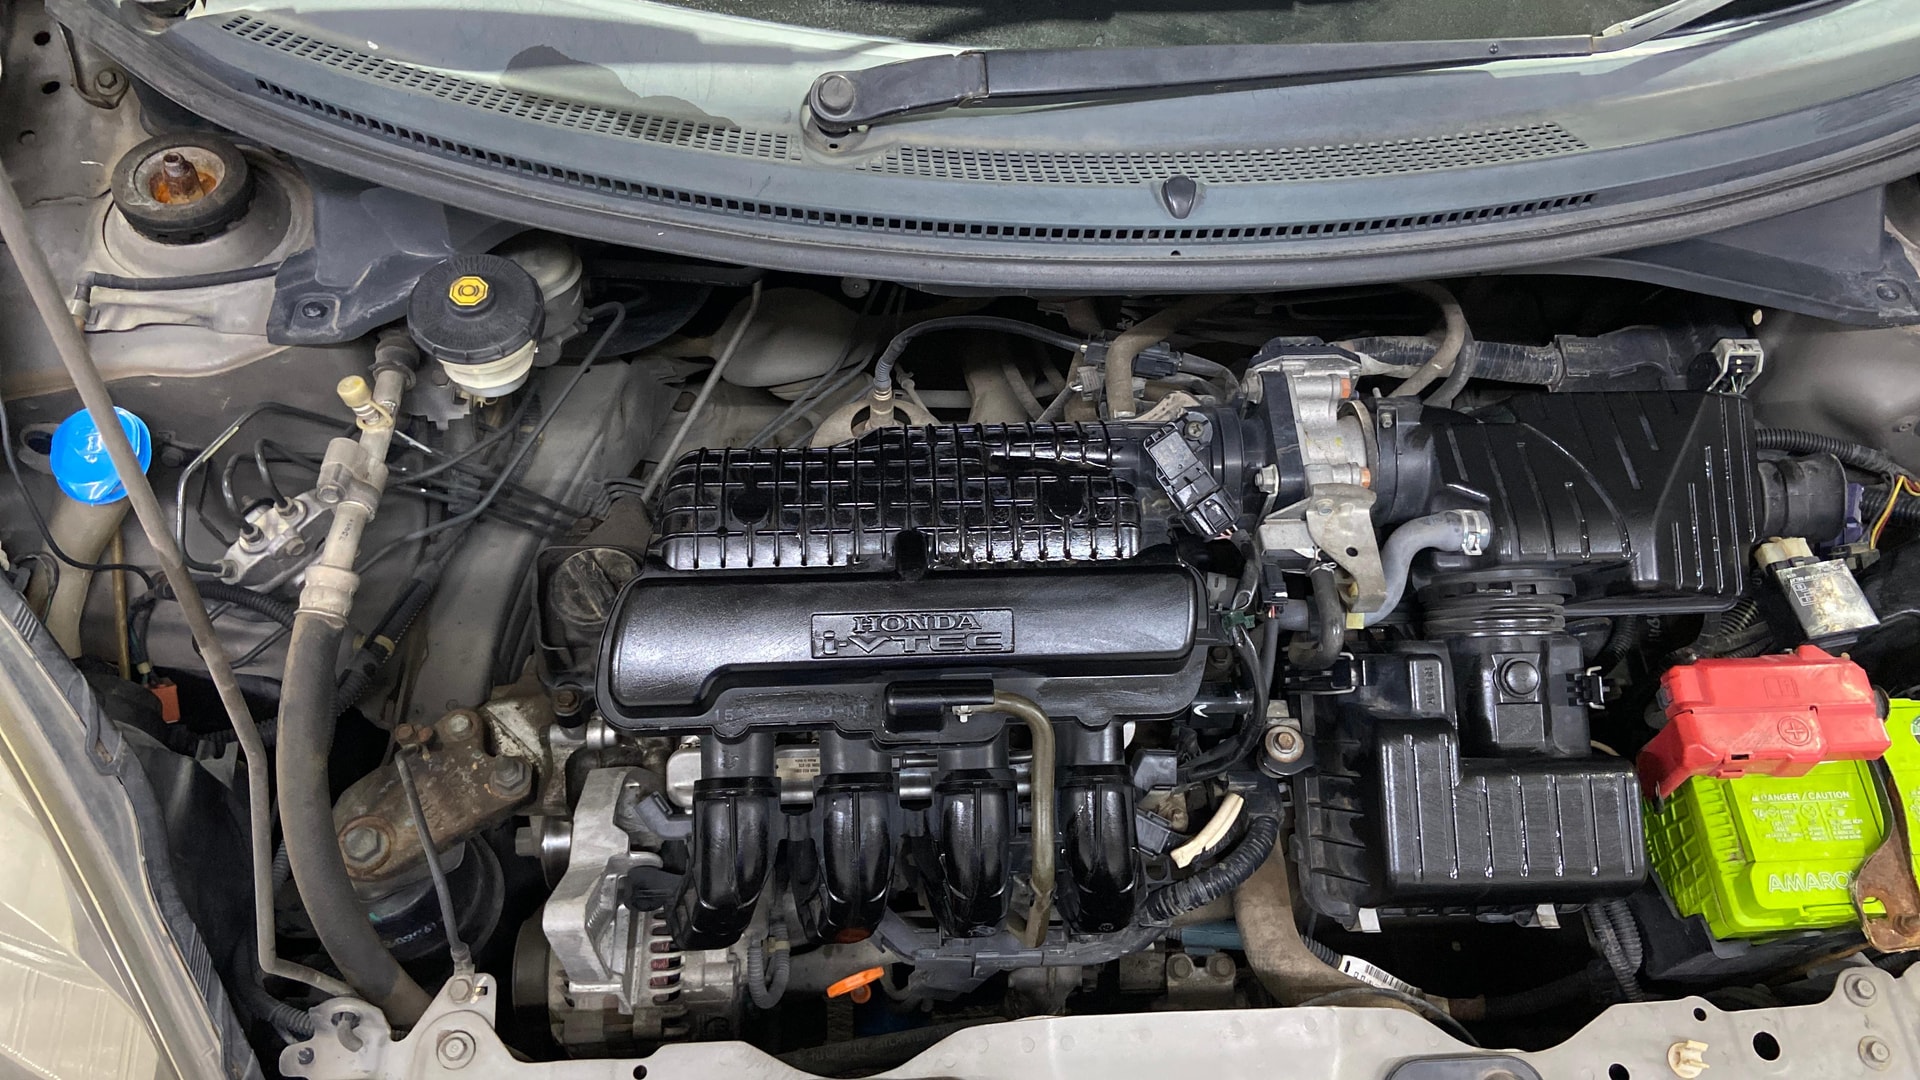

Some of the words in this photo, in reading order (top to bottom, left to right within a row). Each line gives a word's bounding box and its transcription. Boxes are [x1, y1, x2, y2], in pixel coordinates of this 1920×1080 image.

[853, 613, 982, 633] HONDA
[823, 630, 1003, 655] i-VTEC
[1760, 792, 1800, 801] DANGER
[1808, 790, 1850, 800] CAUTION
[1768, 870, 1855, 893] AMARO
